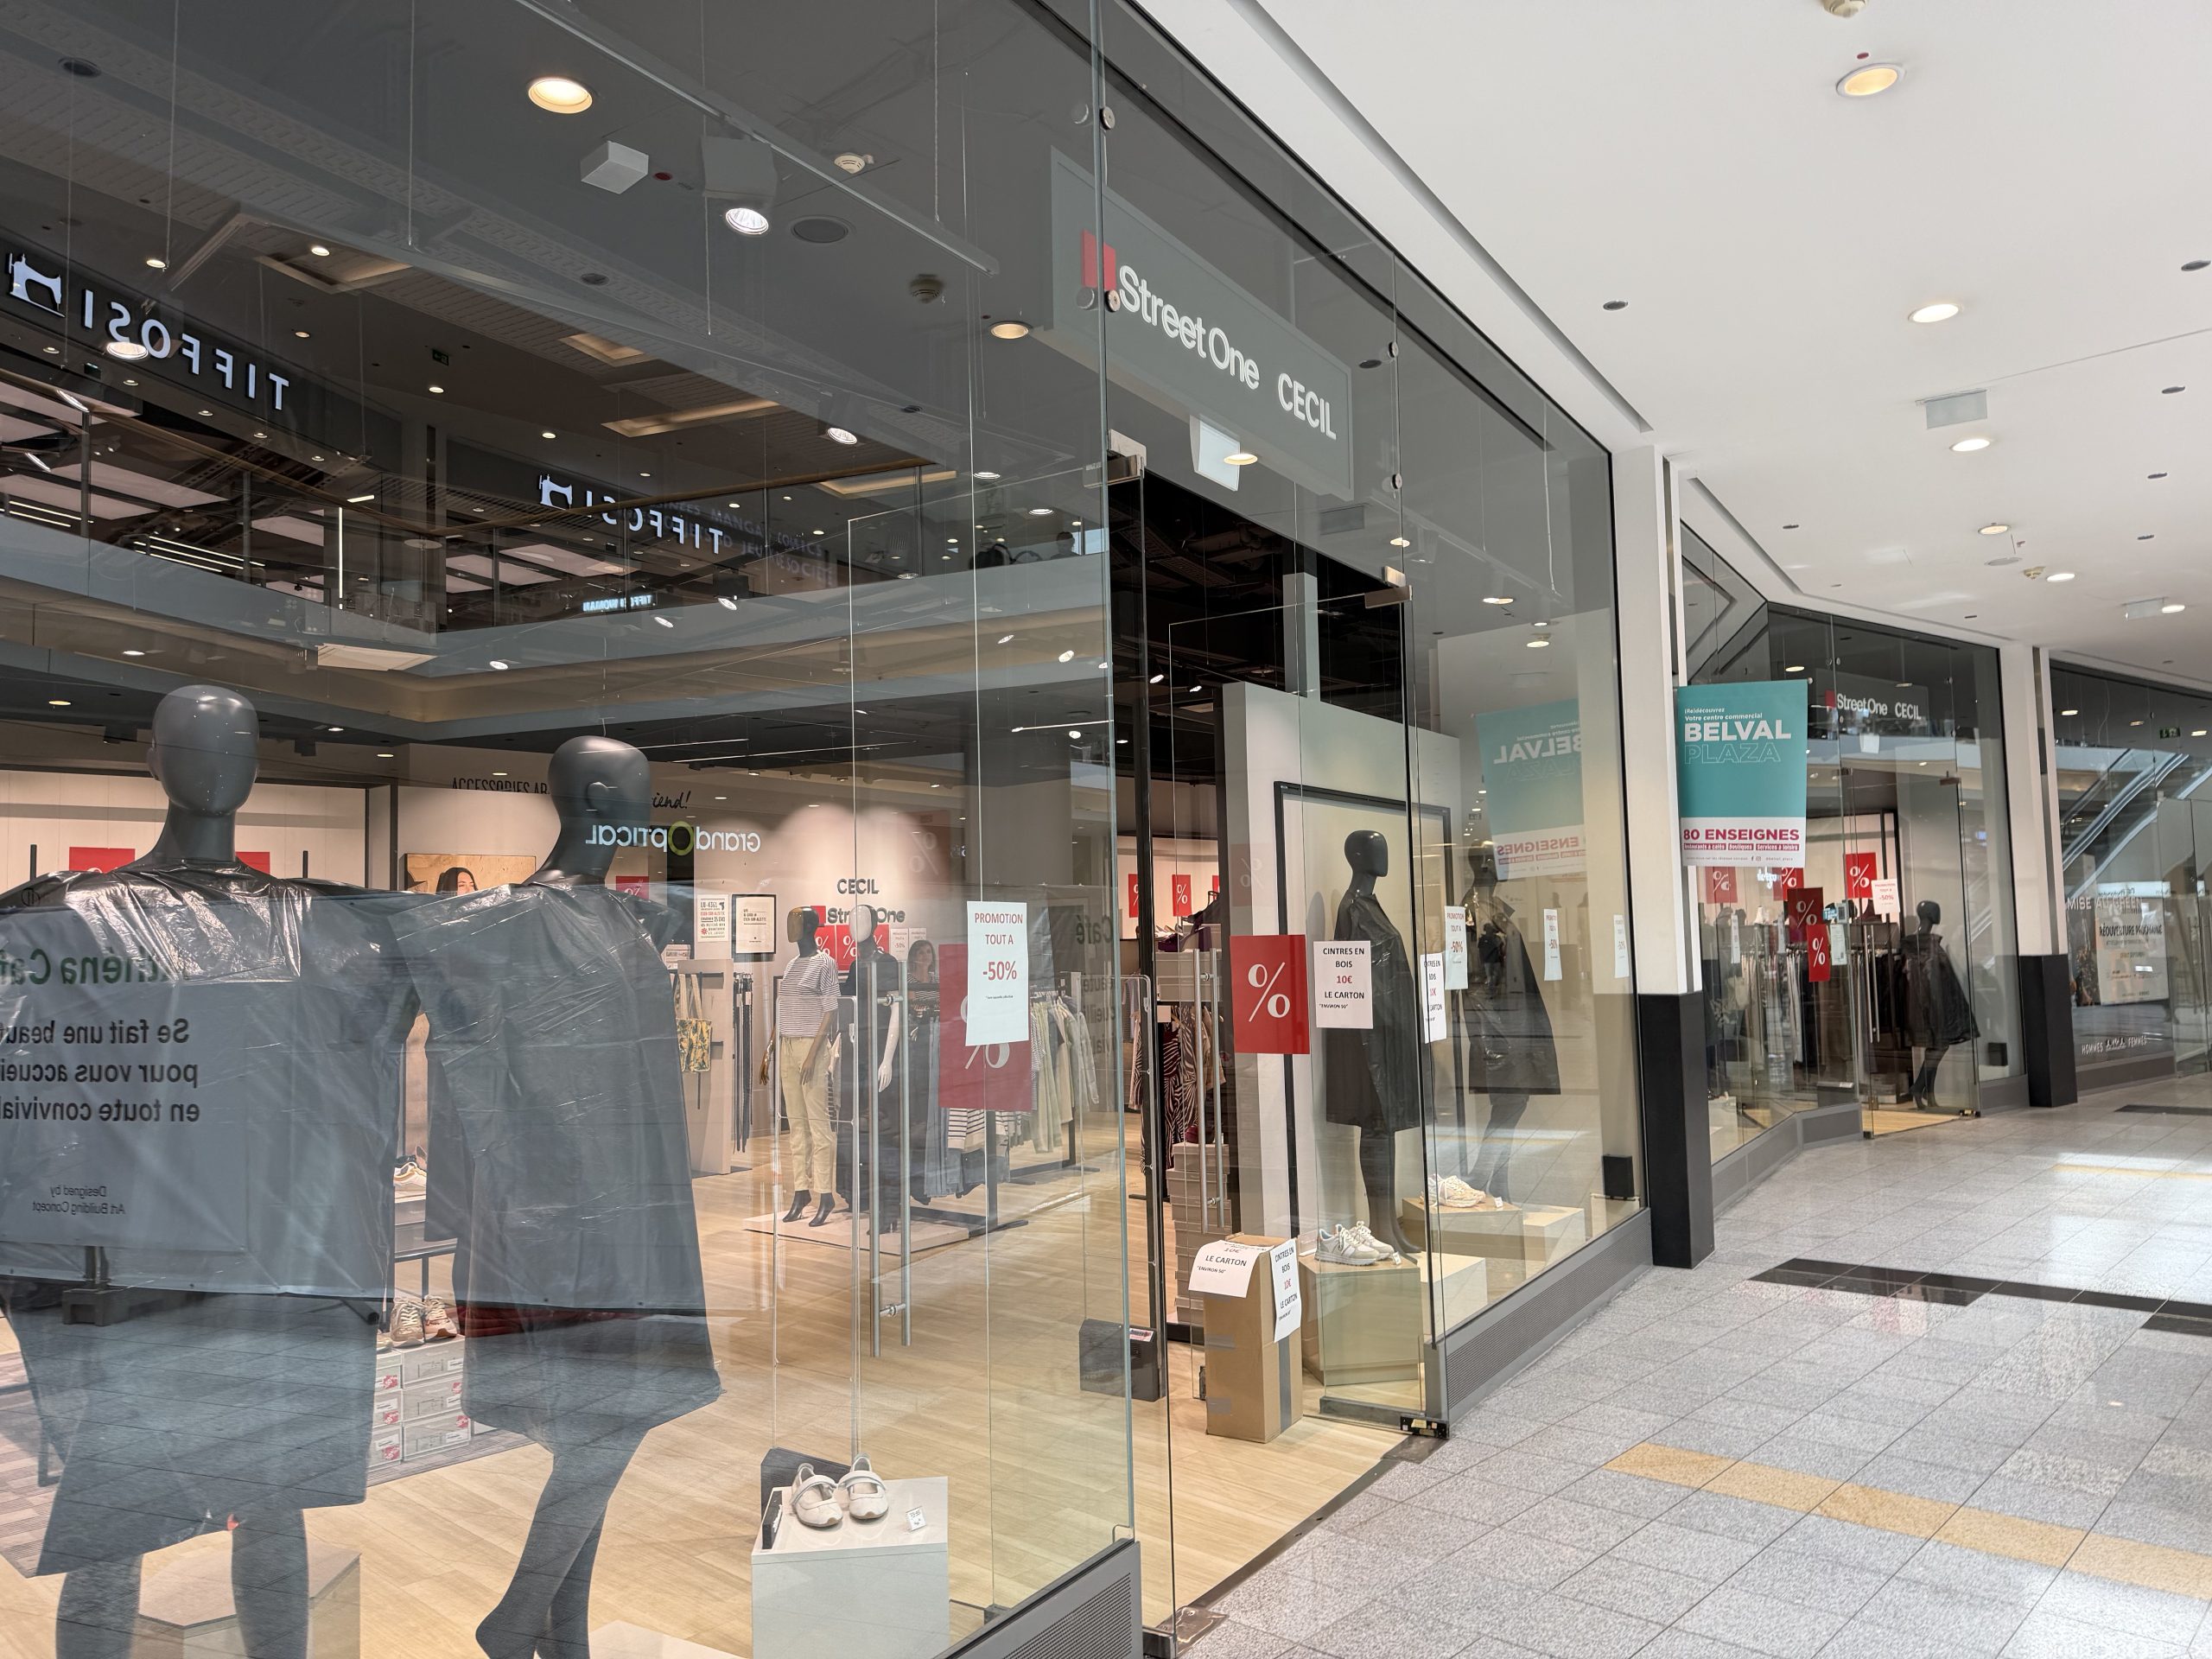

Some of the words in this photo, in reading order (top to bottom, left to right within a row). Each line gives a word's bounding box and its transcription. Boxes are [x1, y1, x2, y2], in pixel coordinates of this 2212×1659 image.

[1120, 265, 1206, 358] Street
[1209, 327, 1259, 390] One
[1278, 373, 1337, 440] CECIL
[1895, 702, 1922, 720] CECIL
[1685, 719, 1791, 742] BELVAL
[1685, 742, 1782, 765] PLAZA
[1684, 830, 1700, 840] 80
[1706, 830, 1799, 841] ENSEIGNES
[837, 879, 880, 894] CECIL
[2067, 897, 2092, 910] MISE
[975, 913, 1023, 924] PROMOTION
[985, 934, 1006, 944] TOUT
[1007, 935, 1014, 944] A
[1451, 941, 1464, 953] -50%
[982, 961, 1017, 981] -50%
[1337, 976, 1353, 984] 10€
[1249, 962, 1291, 1022] %
[2082, 1042, 2104, 1055] HOMMES
[2128, 1035, 2148, 1048] FEMMES
[1216, 1256, 1247, 1267] CARTON
[1275, 1249, 1289, 1262] CINTRES
[1289, 1246, 1294, 1255] EN
[1281, 1262, 1290, 1274] BOIS
[1280, 1300, 1284, 1309] LE
[1285, 1293, 1298, 1306] CARTON
